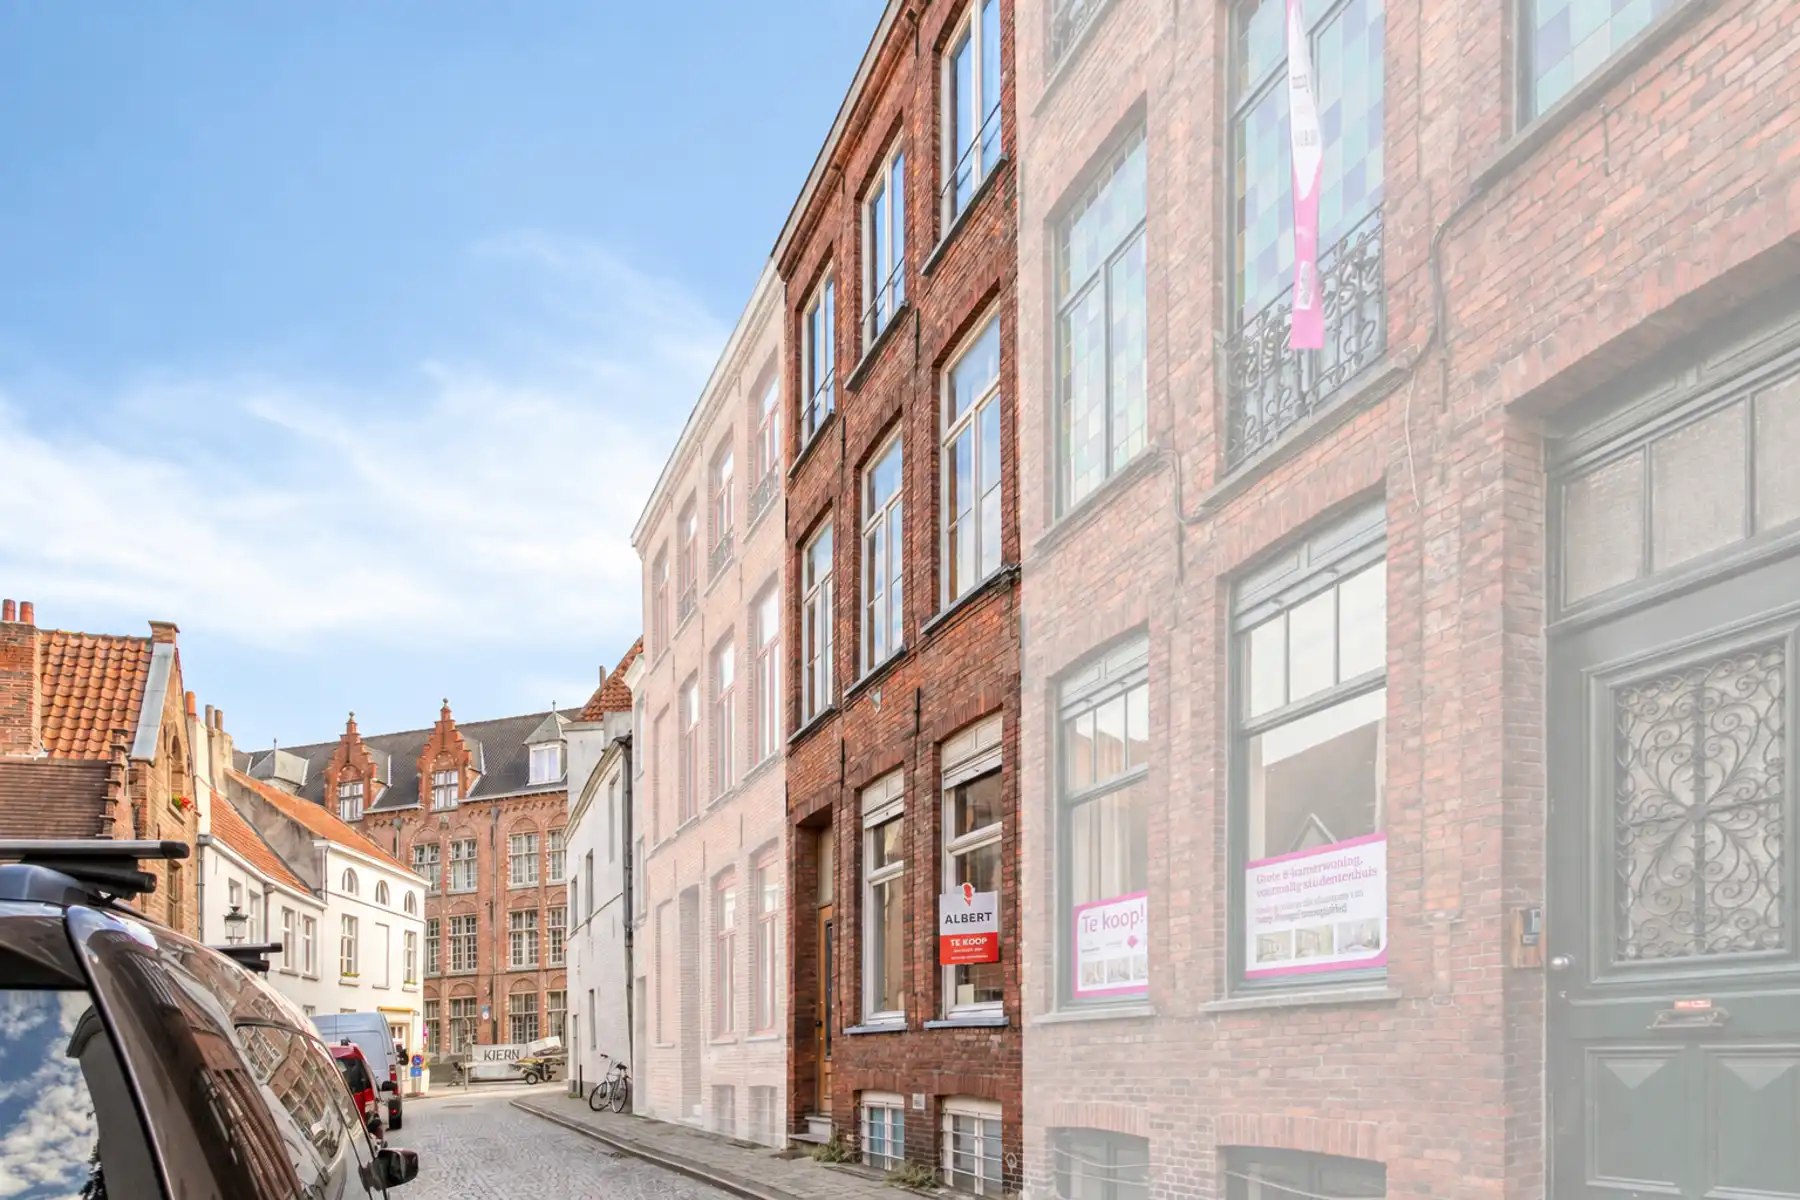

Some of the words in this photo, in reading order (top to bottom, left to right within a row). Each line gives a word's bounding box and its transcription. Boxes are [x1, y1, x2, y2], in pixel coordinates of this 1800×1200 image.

[1303, 866, 1378, 889] studentenhuis
[944, 912, 992, 925] ALBERT
[1081, 915, 1098, 933] Te
[1102, 902, 1144, 930] koop!
[950, 938, 961, 947] TE
[962, 937, 988, 946] KOOP
[484, 1049, 520, 1061] KIERN
